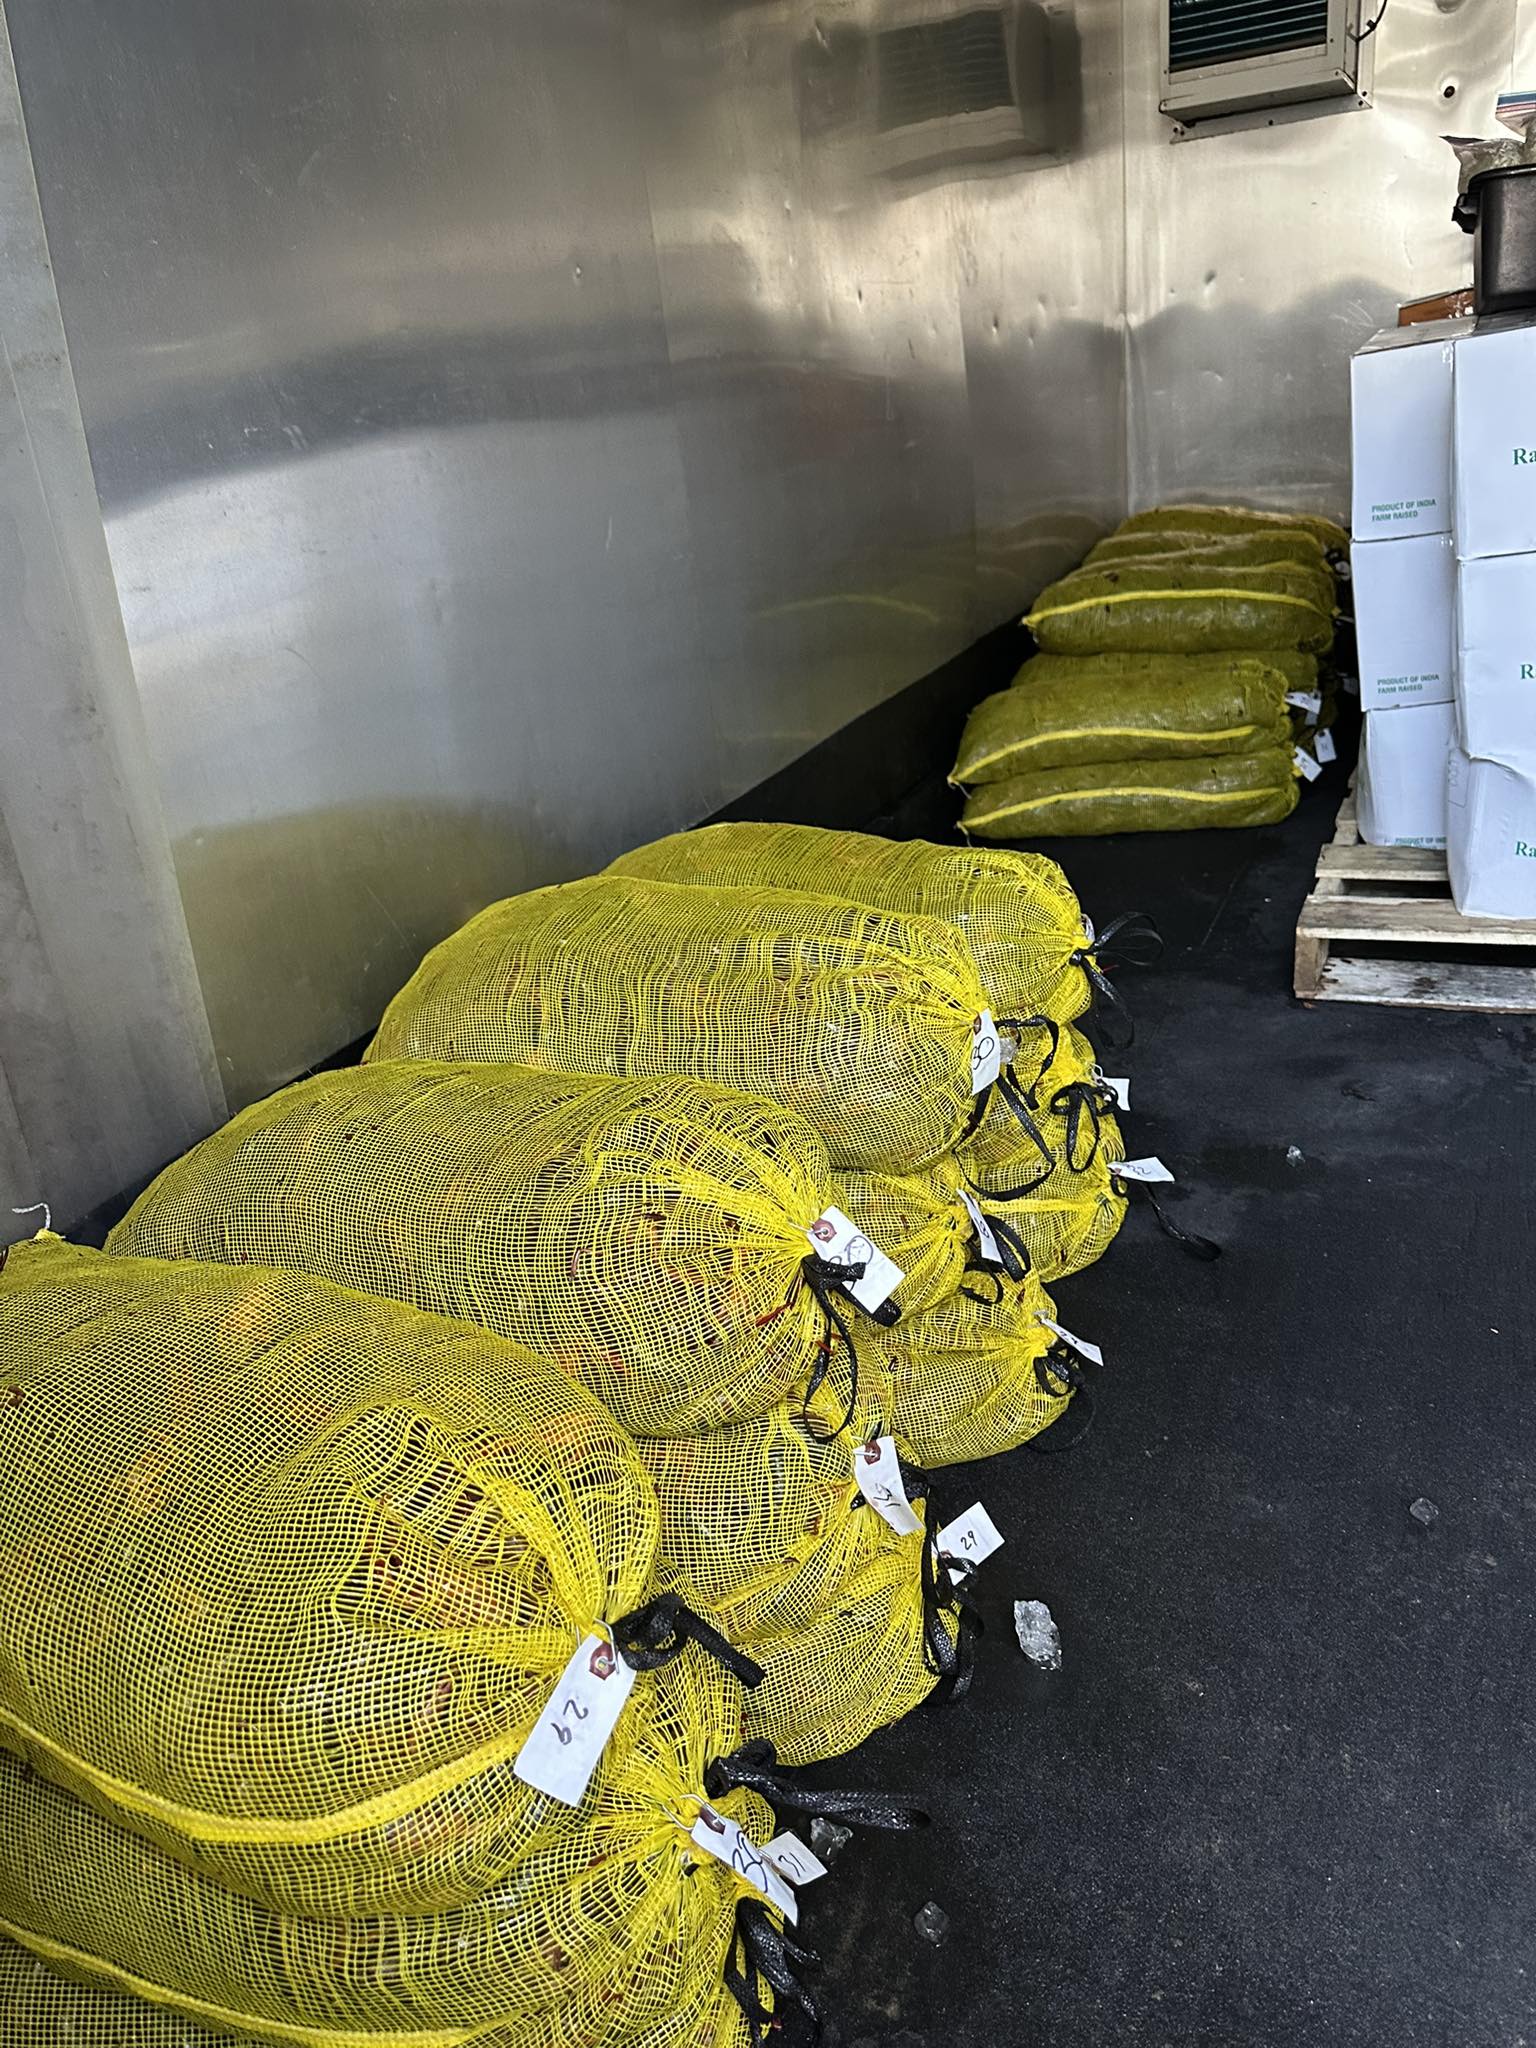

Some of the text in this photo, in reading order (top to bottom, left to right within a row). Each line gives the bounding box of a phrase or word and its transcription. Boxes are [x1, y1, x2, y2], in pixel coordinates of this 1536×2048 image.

[1371, 498, 1437, 512] PRODUCT OF INDIA
[1371, 510, 1418, 521] FARM RAISED
[1377, 673, 1440, 686] PRODUCT OF INDIA
[1377, 683, 1423, 694] FARM RAISED
[960, 1529, 978, 1550] 29
[551, 1698, 589, 1746] 29
[778, 1851, 806, 1878] 31
